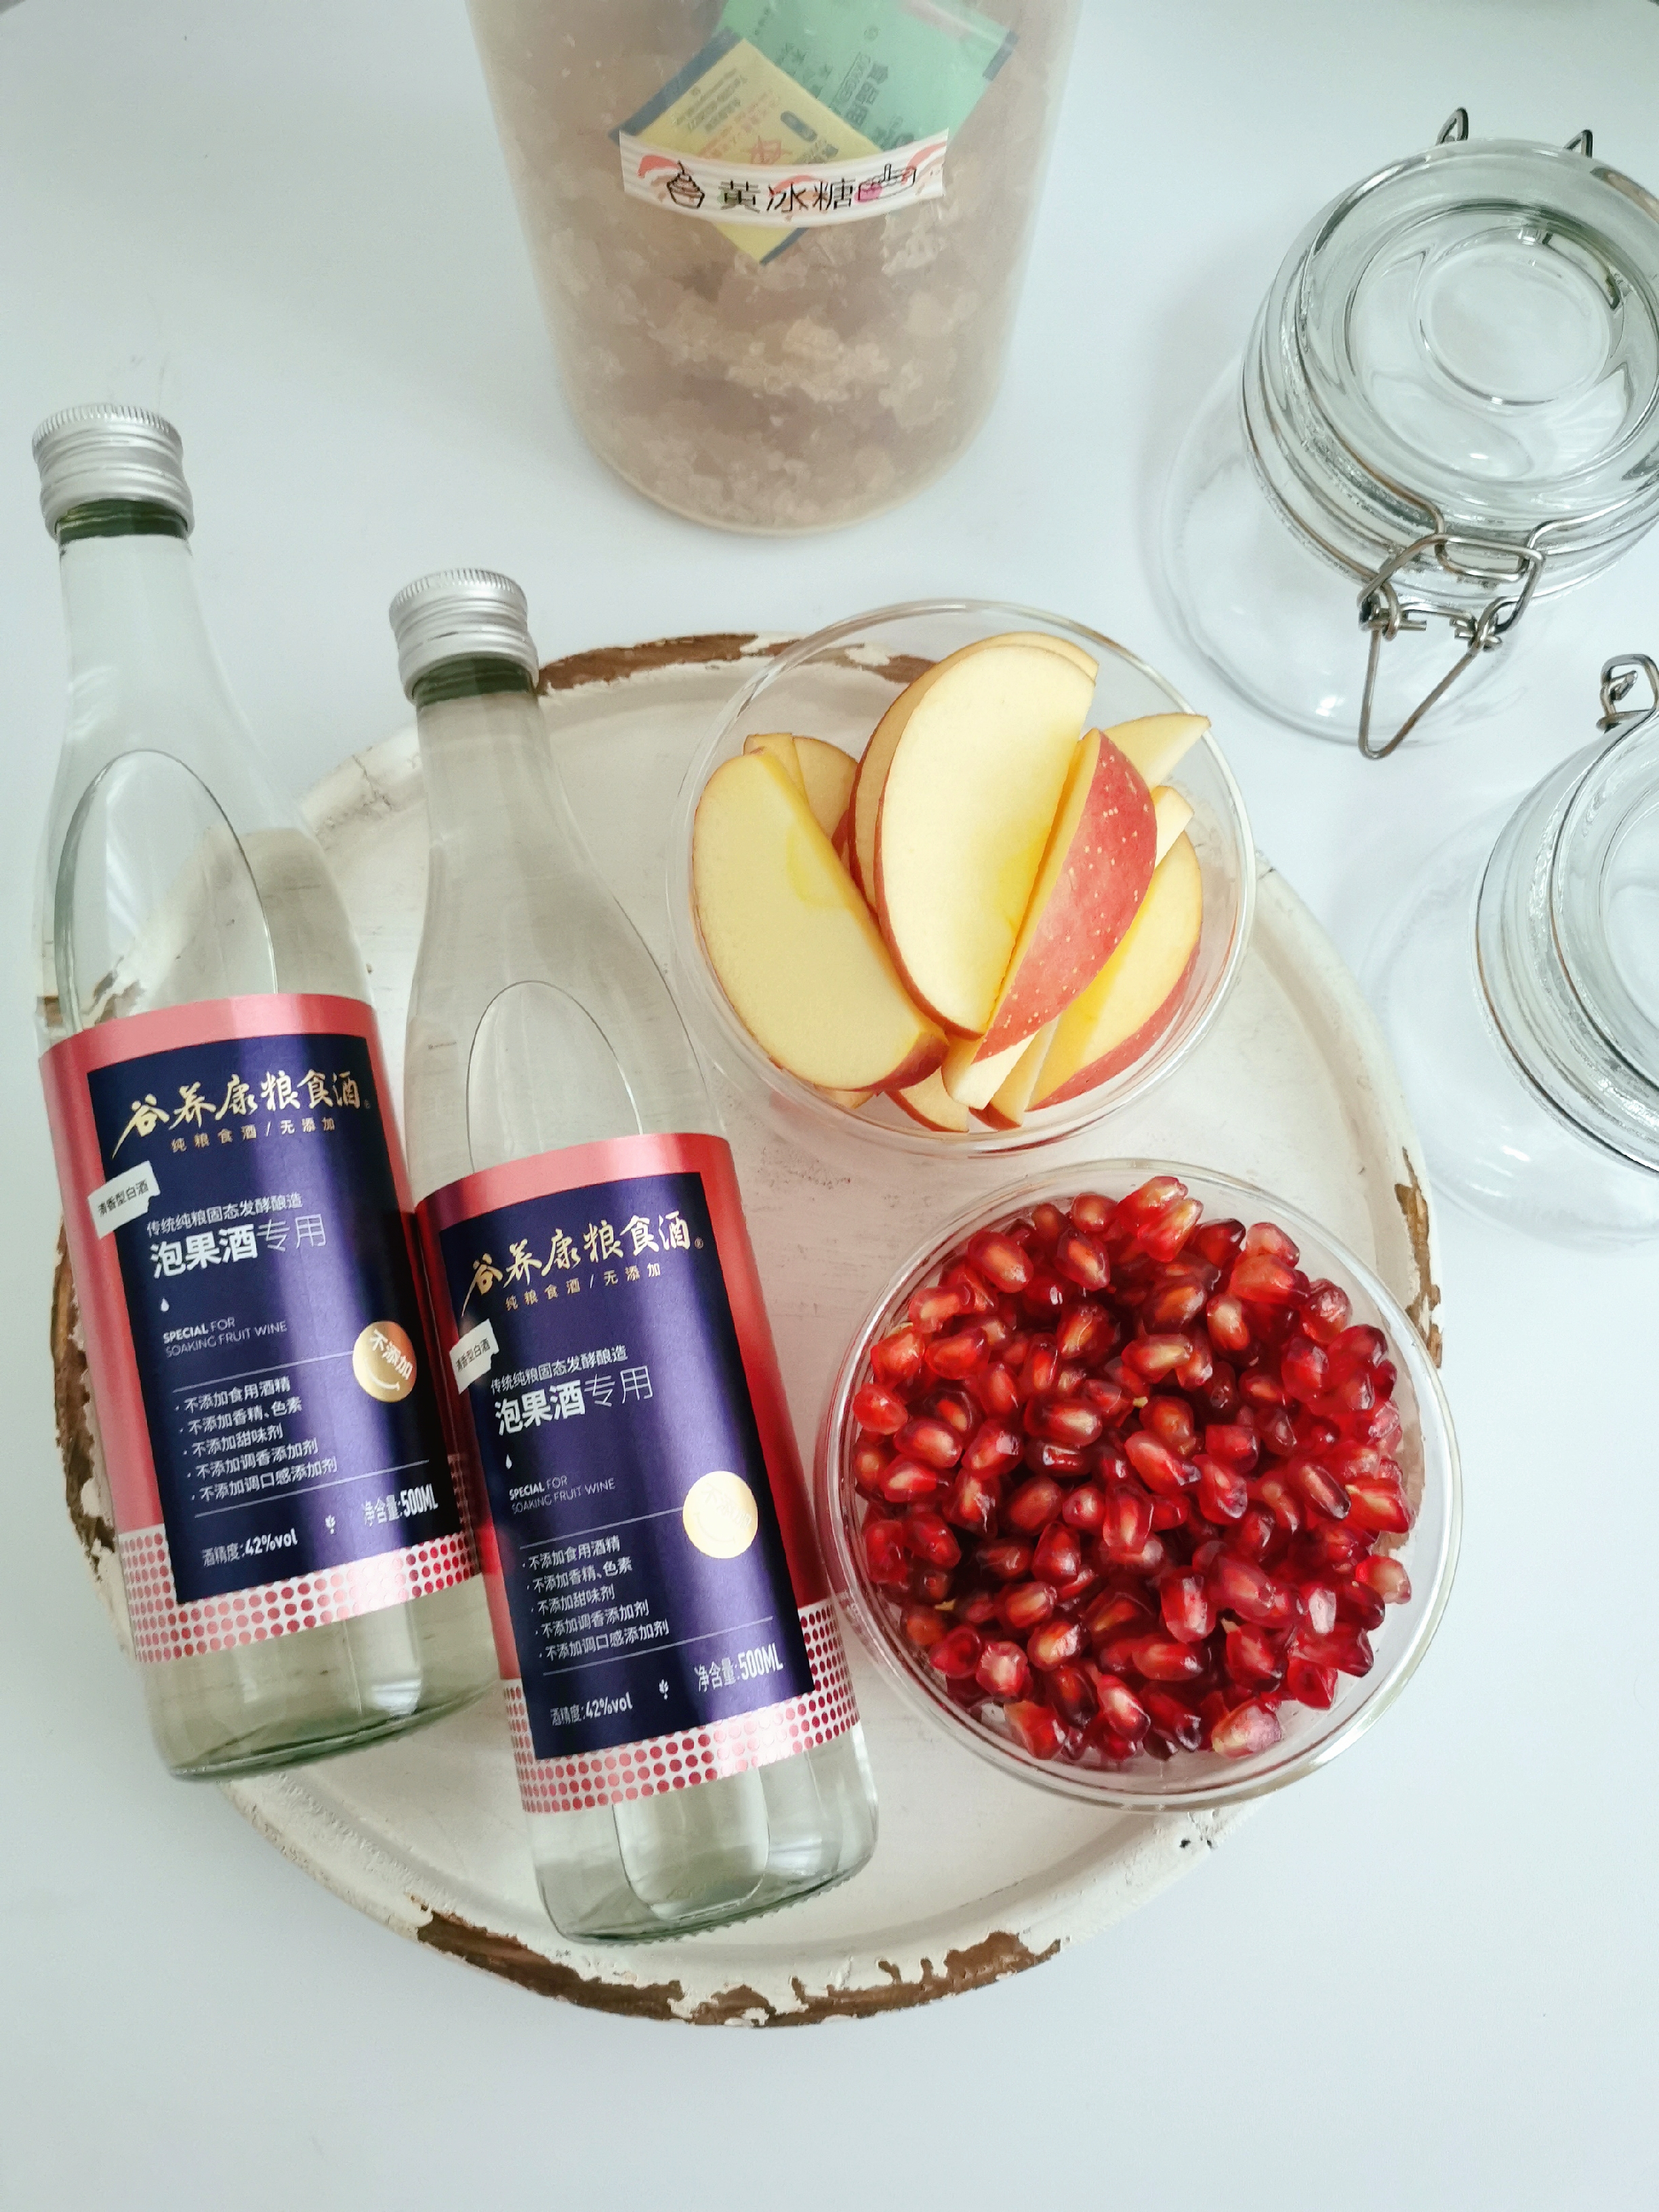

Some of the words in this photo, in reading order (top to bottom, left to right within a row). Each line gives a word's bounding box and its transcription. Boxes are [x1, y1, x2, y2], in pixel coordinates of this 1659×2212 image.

[112, 1069, 361, 1159] 谷养康粮食酒
[98, 1178, 149, 1217] 清香型白酒
[146, 1191, 303, 1238] 传统纯粮固态发酵酿造
[150, 1213, 327, 1279] 泡果酒专用
[461, 1211, 691, 1316] 谷养康粮食酒
[163, 1323, 209, 1344] SPECIAL
[211, 1317, 235, 1332] FOR
[165, 1335, 218, 1357] SOAKING
[219, 1328, 251, 1344] FRUIT
[252, 1320, 287, 1336] WINE
[369, 1329, 413, 1380] 不添加
[490, 1345, 628, 1395] 传统纯粮固态发酵酿造
[184, 1376, 291, 1414] 不添加食用酒精
[494, 1366, 654, 1437] 泡果酒专用
[188, 1397, 302, 1435] 不添加香精、色素
[192, 1424, 283, 1458] 不添加甜味剂
[196, 1438, 319, 1481] 不添加调香添加剂
[200, 1458, 338, 1502] 不添加调口感添加剂
[509, 1483, 545, 1500] SPECIAL
[546, 1475, 568, 1490] FOR
[511, 1494, 552, 1514] SOAKING
[553, 1488, 583, 1503] FRUIT
[583, 1477, 615, 1495] WINE
[529, 1535, 620, 1570] 不添加食用酒精
[533, 1557, 632, 1593] 不添加香精、色素
[537, 1584, 615, 1616] 不添加甜味剂
[541, 1599, 649, 1639] 不添加调香添加剂
[545, 1618, 670, 1662] 不添加调口感添加剂
